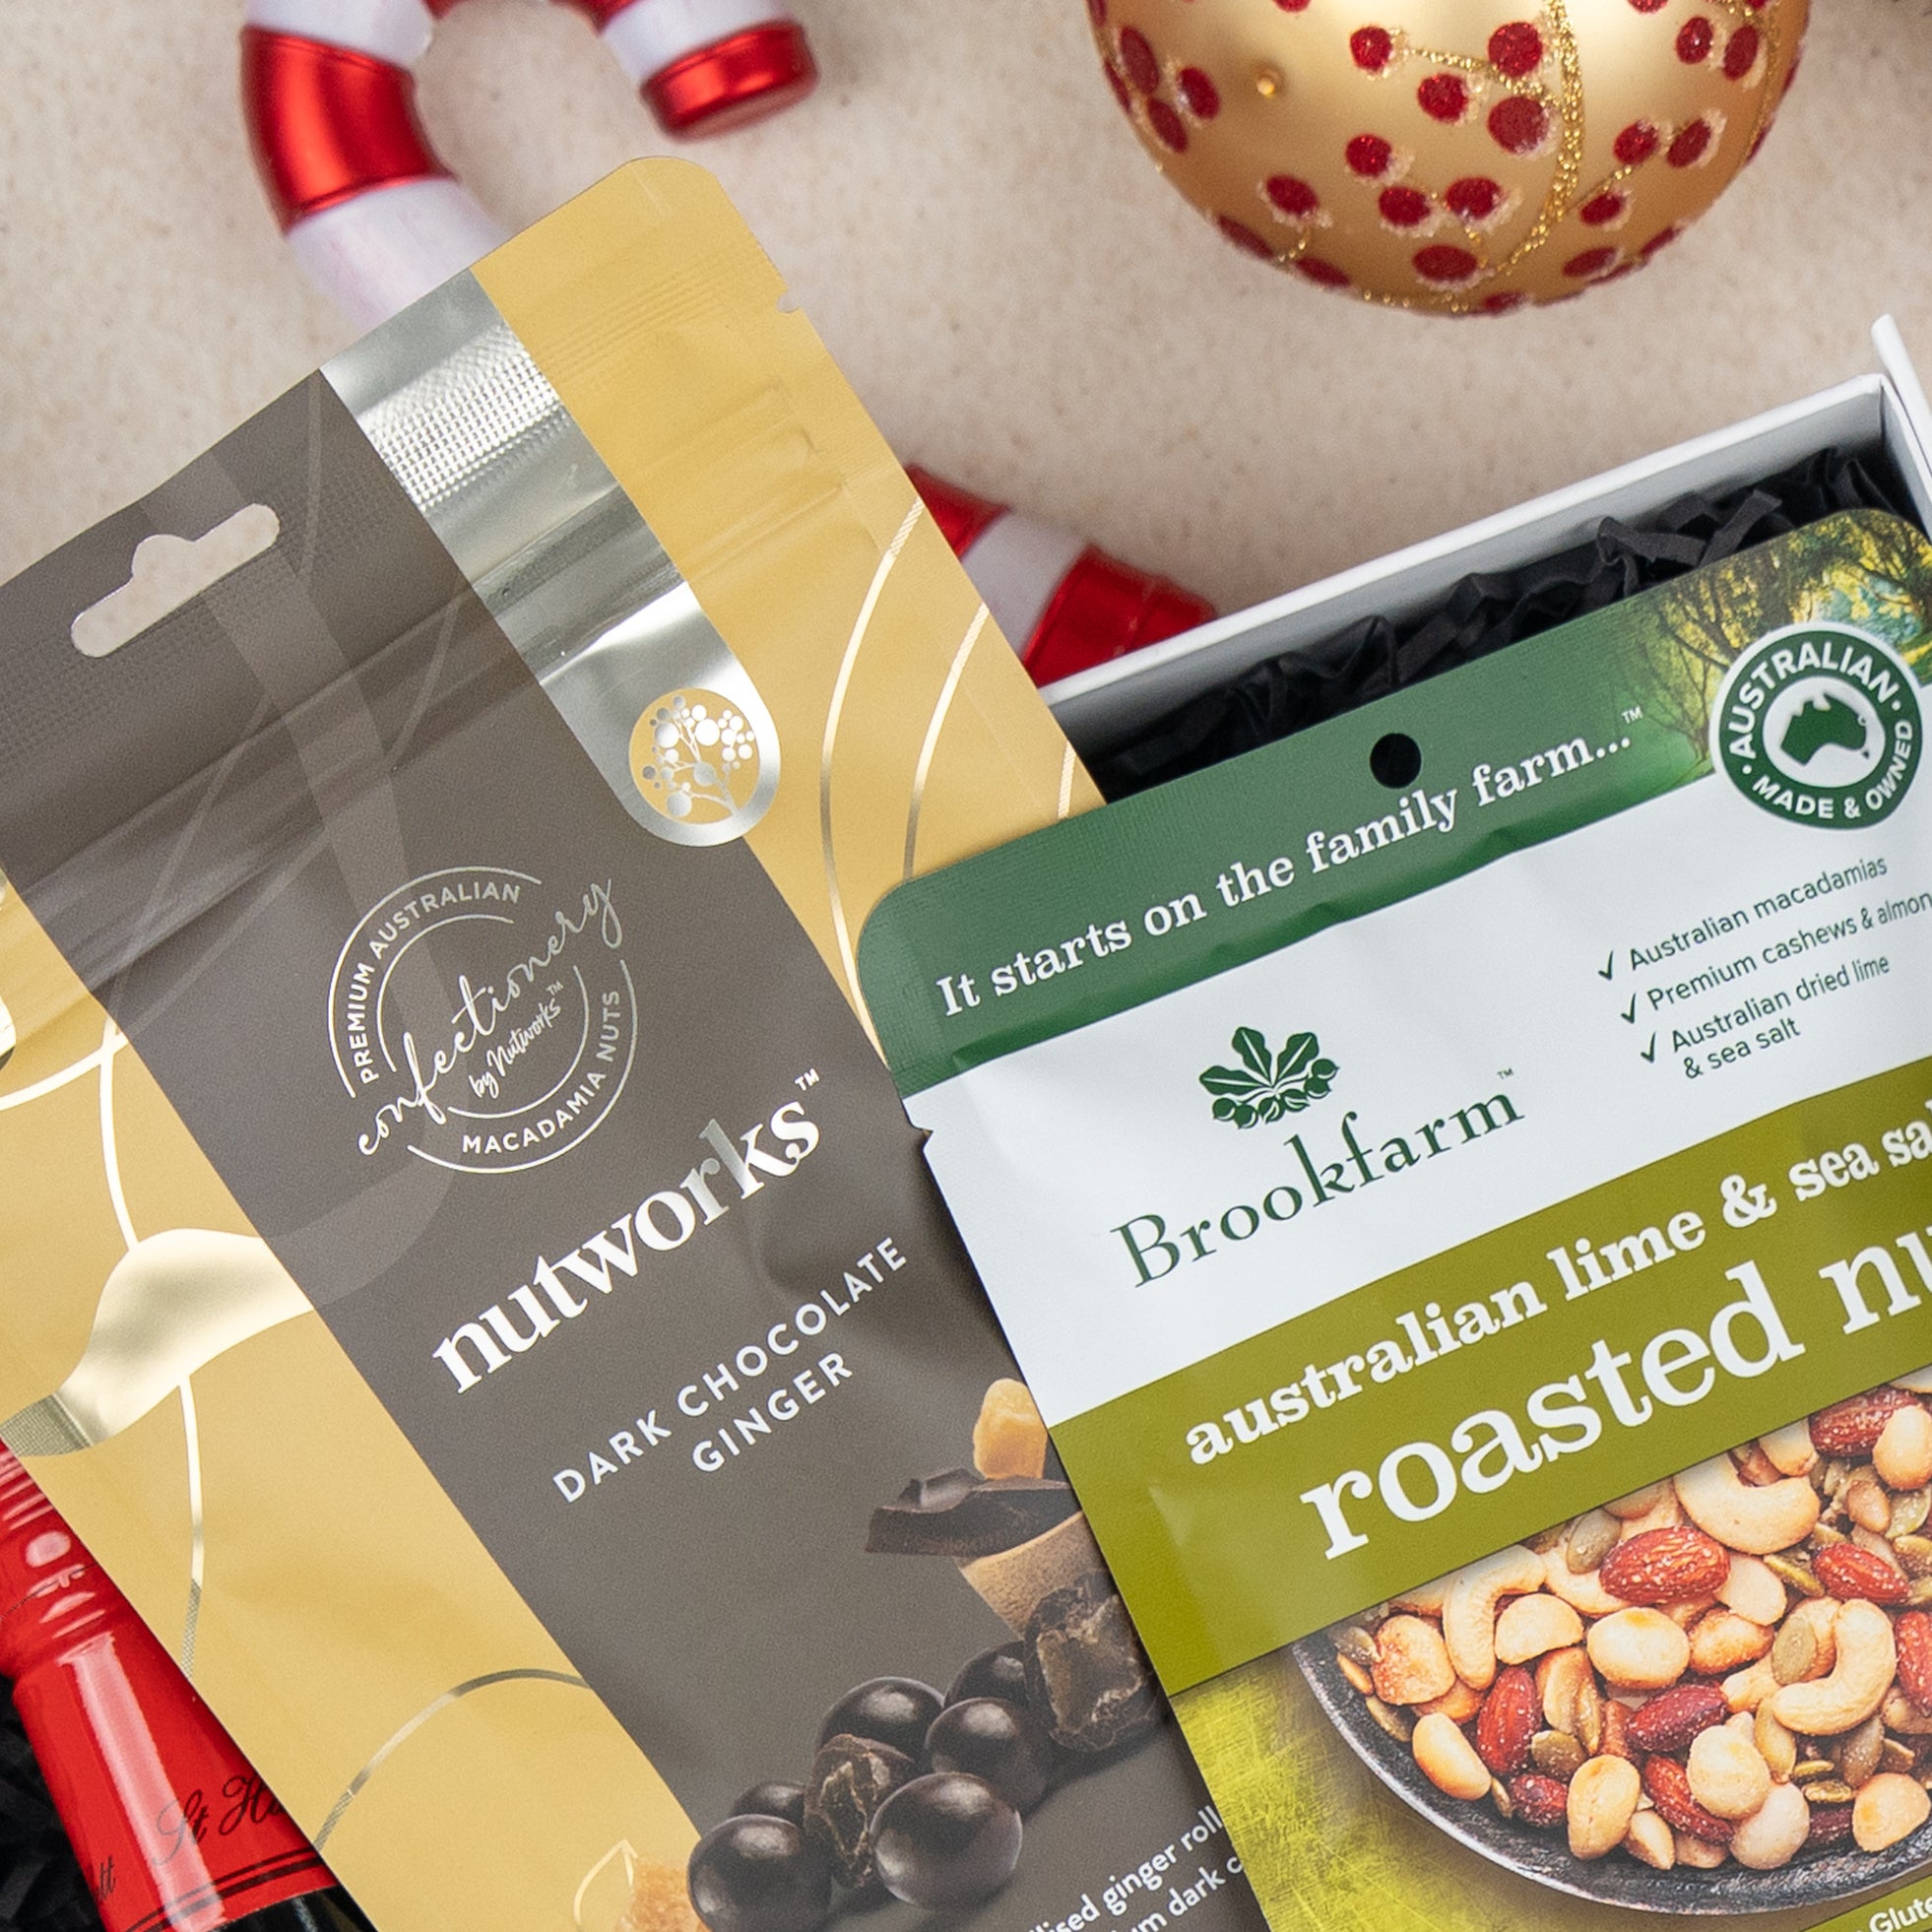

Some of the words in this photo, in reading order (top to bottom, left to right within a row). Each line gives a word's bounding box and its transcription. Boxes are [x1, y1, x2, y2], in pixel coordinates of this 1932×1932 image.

[1728, 641, 1900, 759] AUSTRALIAN
[1752, 775, 1835, 819] MADE
[1843, 797, 1861, 818] &
[1865, 720, 1913, 810] OWNED
[936, 973, 981, 1016] It
[991, 920, 1132, 998] starts
[1144, 891, 1207, 936] on
[1215, 856, 1296, 908] the
[1305, 788, 1458, 874] family
[1630, 908, 1750, 971] Australian
[1754, 856, 1888, 920] macadamias
[1647, 954, 1758, 1010] Premium
[1763, 916, 1858, 965] cashews
[1860, 907, 1874, 931] &
[347, 962, 379, 1084] PREMIUM
[368, 881, 521, 960] AUSTRALIAN
[357, 878, 622, 1156] confectionery
[1671, 990, 1791, 1053] Australian
[1796, 963, 1850, 1002] dried
[1854, 953, 1891, 984] lime
[462, 1071, 607, 1154] MACADAMIA
[597, 991, 621, 1062] NUTS
[469, 1072, 500, 1099] by
[486, 998, 562, 1077] Nutworks
[1683, 1056, 1704, 1079] &
[1707, 1039, 1752, 1069] sea
[1756, 1016, 1801, 1050] salt
[431, 1101, 820, 1394] nutworks
[1109, 1092, 1525, 1288] Brookfarm
[1184, 1278, 1548, 1465] australian
[1546, 1209, 1707, 1301] lime
[1719, 1174, 1777, 1228] &
[1789, 1142, 1880, 1202] sea
[1882, 1098, 1932, 1168] sa
[553, 1408, 673, 1503] DARK
[676, 1237, 908, 1417] CHOCOLATE
[692, 1352, 853, 1472] GINGER
[1300, 1259, 1806, 1562] roasted
[1103, 1843, 1177, 1917] ginger
[1168, 1867, 1226, 1917] dark
